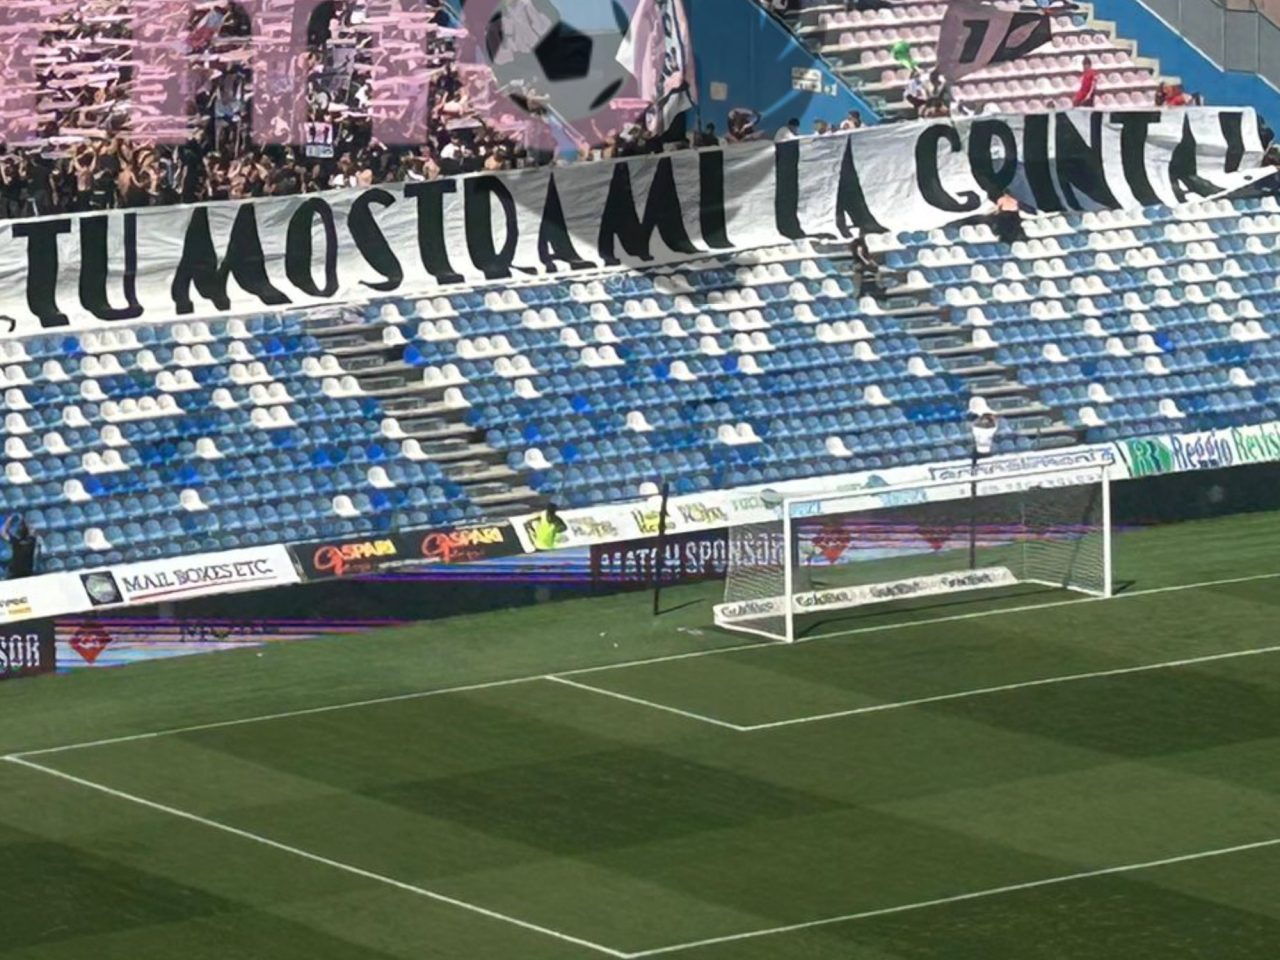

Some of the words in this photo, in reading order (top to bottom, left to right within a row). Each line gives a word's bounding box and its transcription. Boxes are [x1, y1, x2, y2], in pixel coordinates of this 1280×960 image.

[13, 212, 145, 327] TU
[173, 150, 735, 316] MOSTRAMI
[775, 135, 891, 242] LA
[122, 571, 174, 592] MAIL
[173, 562, 233, 586] BOXES
